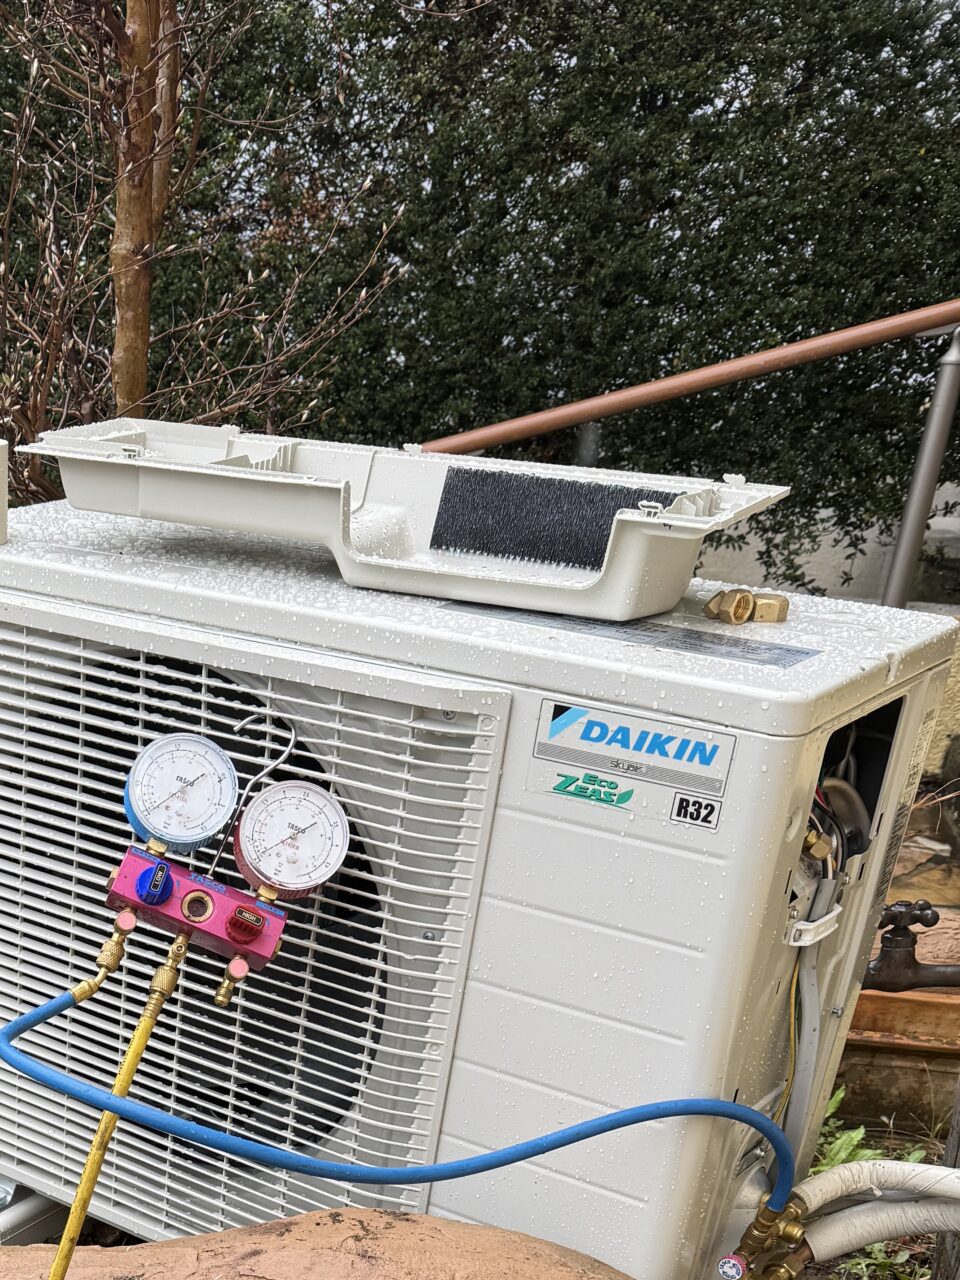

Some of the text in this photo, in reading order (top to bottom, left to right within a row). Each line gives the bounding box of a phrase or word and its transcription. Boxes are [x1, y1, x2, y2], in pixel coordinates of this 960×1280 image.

[580, 720, 720, 766] DAIKIN
[676, 797, 716, 824] R32
[242, 911, 257, 923] HIGH
